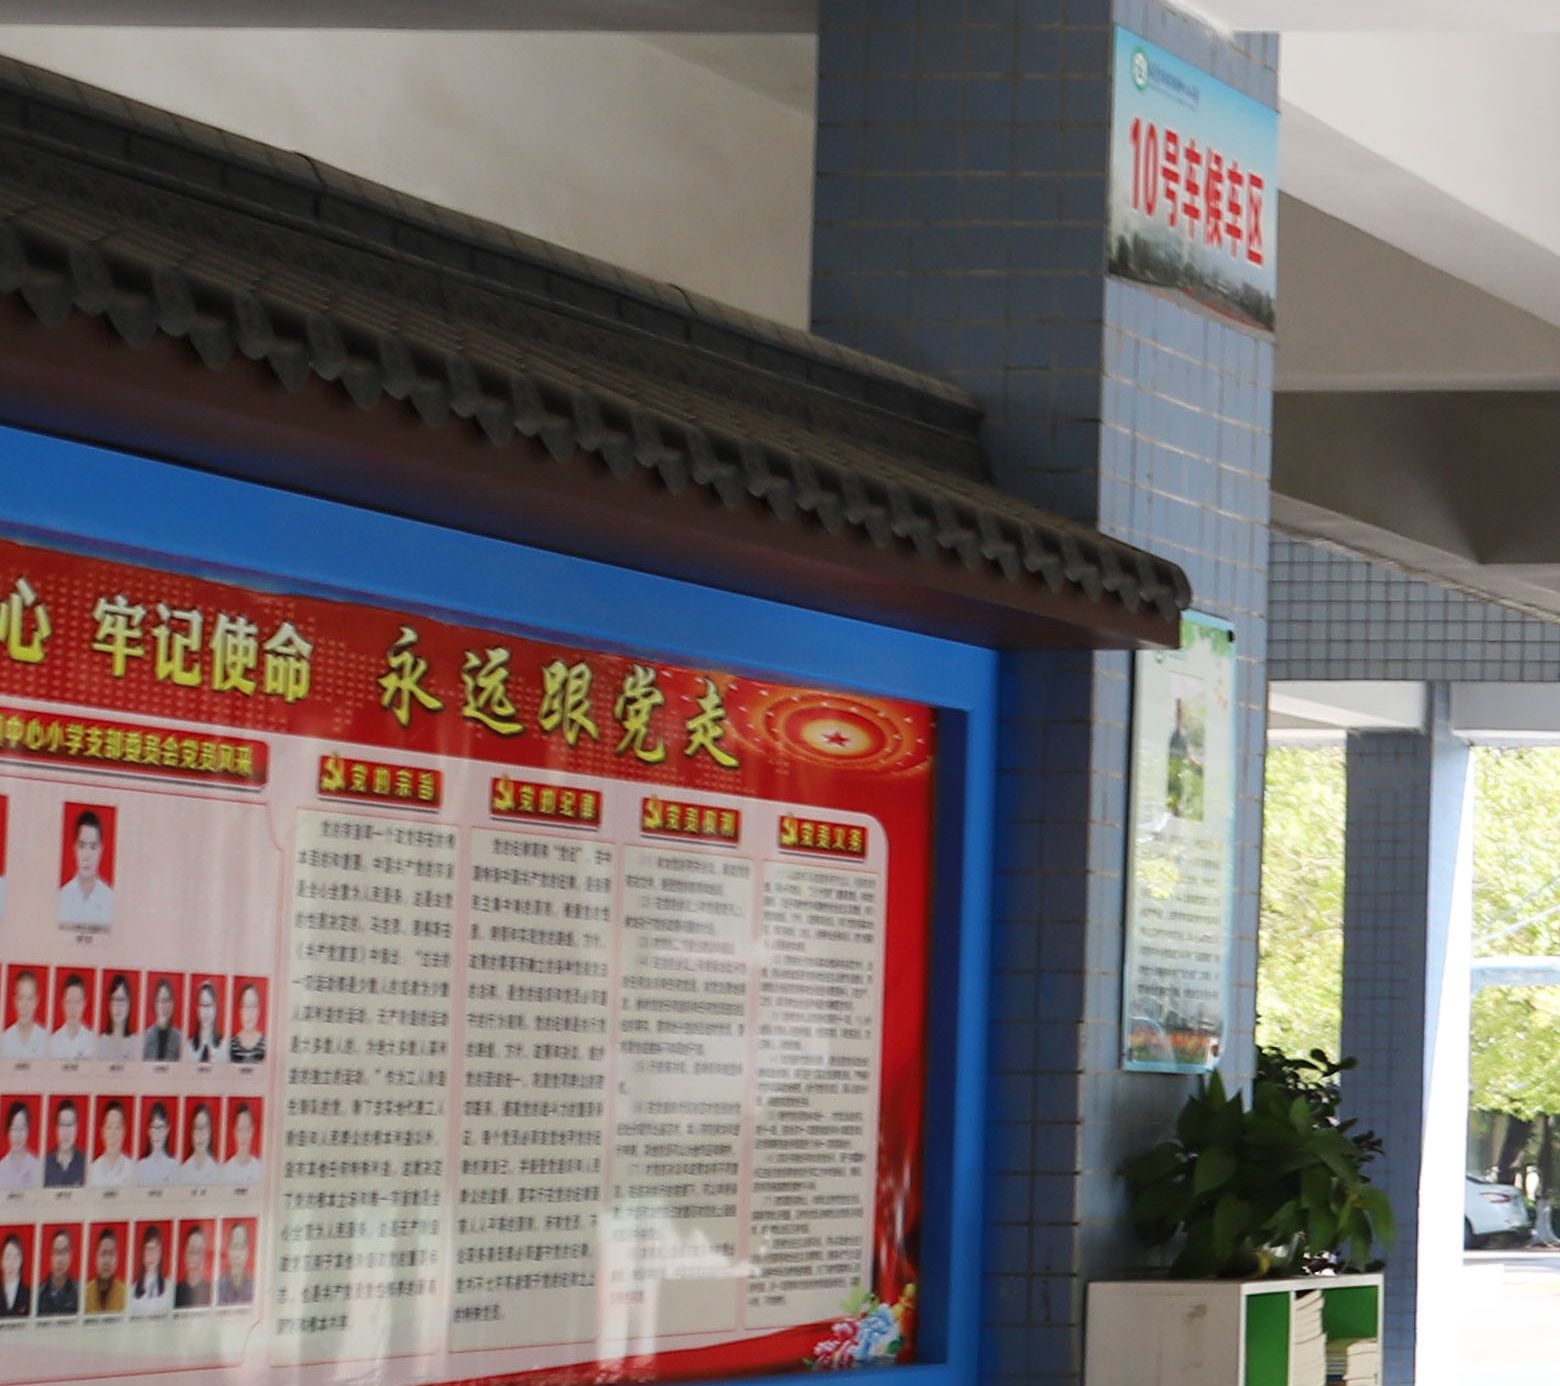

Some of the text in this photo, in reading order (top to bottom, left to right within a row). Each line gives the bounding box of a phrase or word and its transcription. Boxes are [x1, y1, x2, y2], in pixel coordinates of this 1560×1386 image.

[1130, 116, 1264, 266] 10号车候车区
[92, 595, 313, 703] 牢记使命
[378, 626, 740, 767] 永远跟党走
[0, 715, 252, 776] 中心小学支部委员会党员风采
[351, 764, 434, 801] 党的宗旨
[519, 785, 596, 818] 党的纪律
